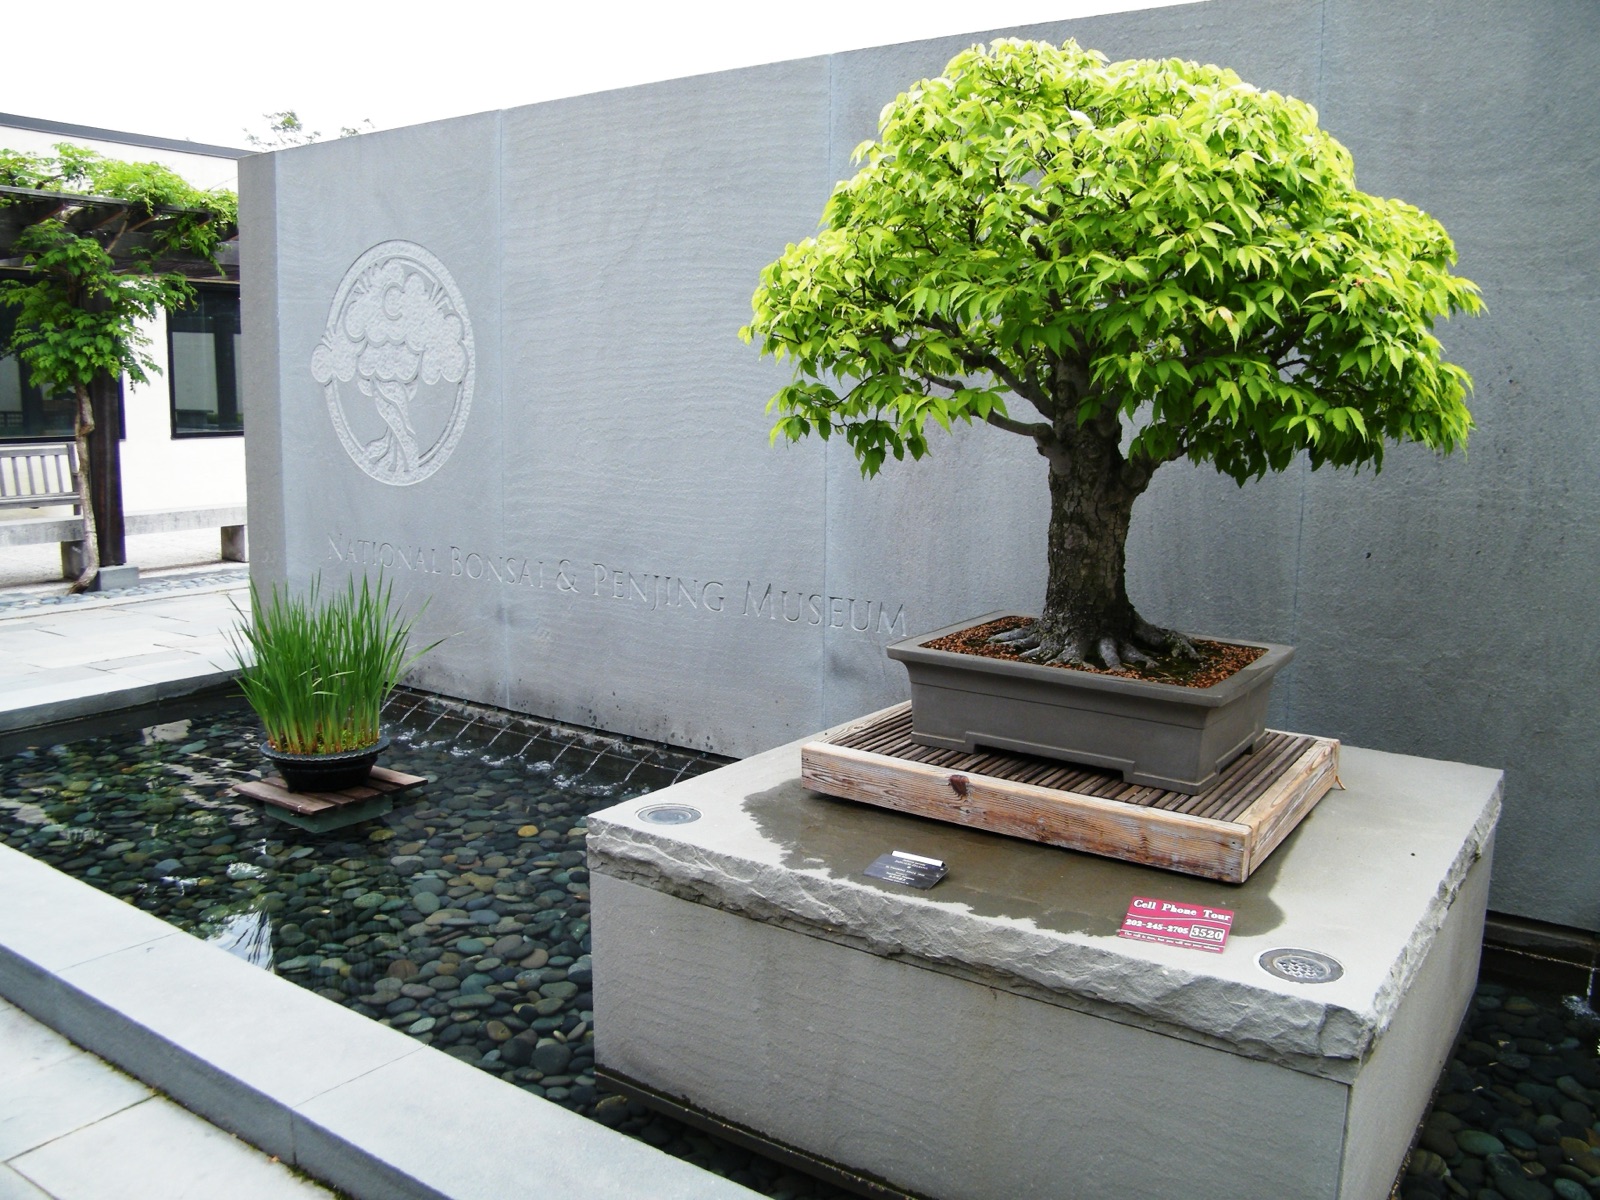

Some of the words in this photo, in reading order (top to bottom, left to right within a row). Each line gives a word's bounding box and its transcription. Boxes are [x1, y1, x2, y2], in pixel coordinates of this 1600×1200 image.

[327, 532, 442, 575] NATIONAL
[449, 545, 545, 589] BONSAI
[555, 558, 580, 594] &
[591, 562, 726, 613] PENJING
[742, 580, 908, 637] MUSEUM
[1133, 899, 1157, 910] Cell
[1161, 903, 1197, 916] Phone
[1203, 909, 1232, 922] Tour
[1191, 927, 1223, 940] 3520
